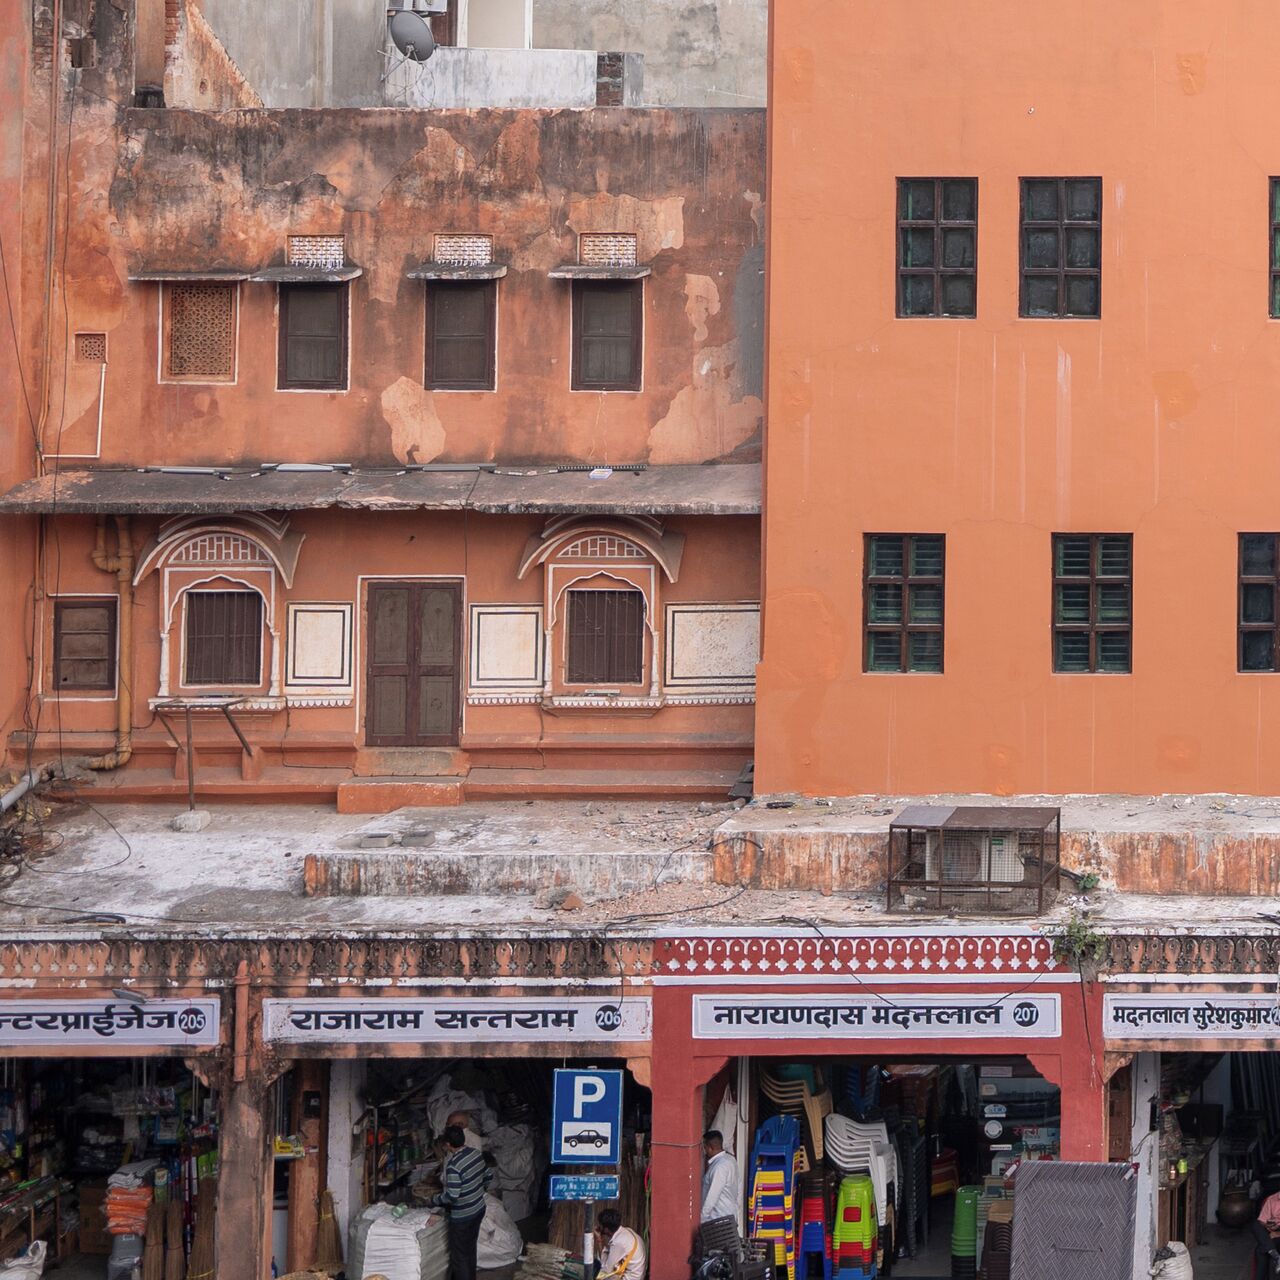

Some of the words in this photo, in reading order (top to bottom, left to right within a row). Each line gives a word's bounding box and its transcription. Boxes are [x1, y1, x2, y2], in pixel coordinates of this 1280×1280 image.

[179, 1013, 206, 1031] 205
[288, 1010, 424, 1031] राजाराम
[435, 1010, 579, 1031] सन्तराम
[595, 1010, 622, 1026] 206
[714, 1006, 867, 1029] नारायणदास
[872, 1006, 1003, 1029] मदनलाल
[1013, 1007, 1039, 1023] 207
[1113, 1006, 1190, 1027] मदनलाल
[573, 1076, 606, 1119] P
